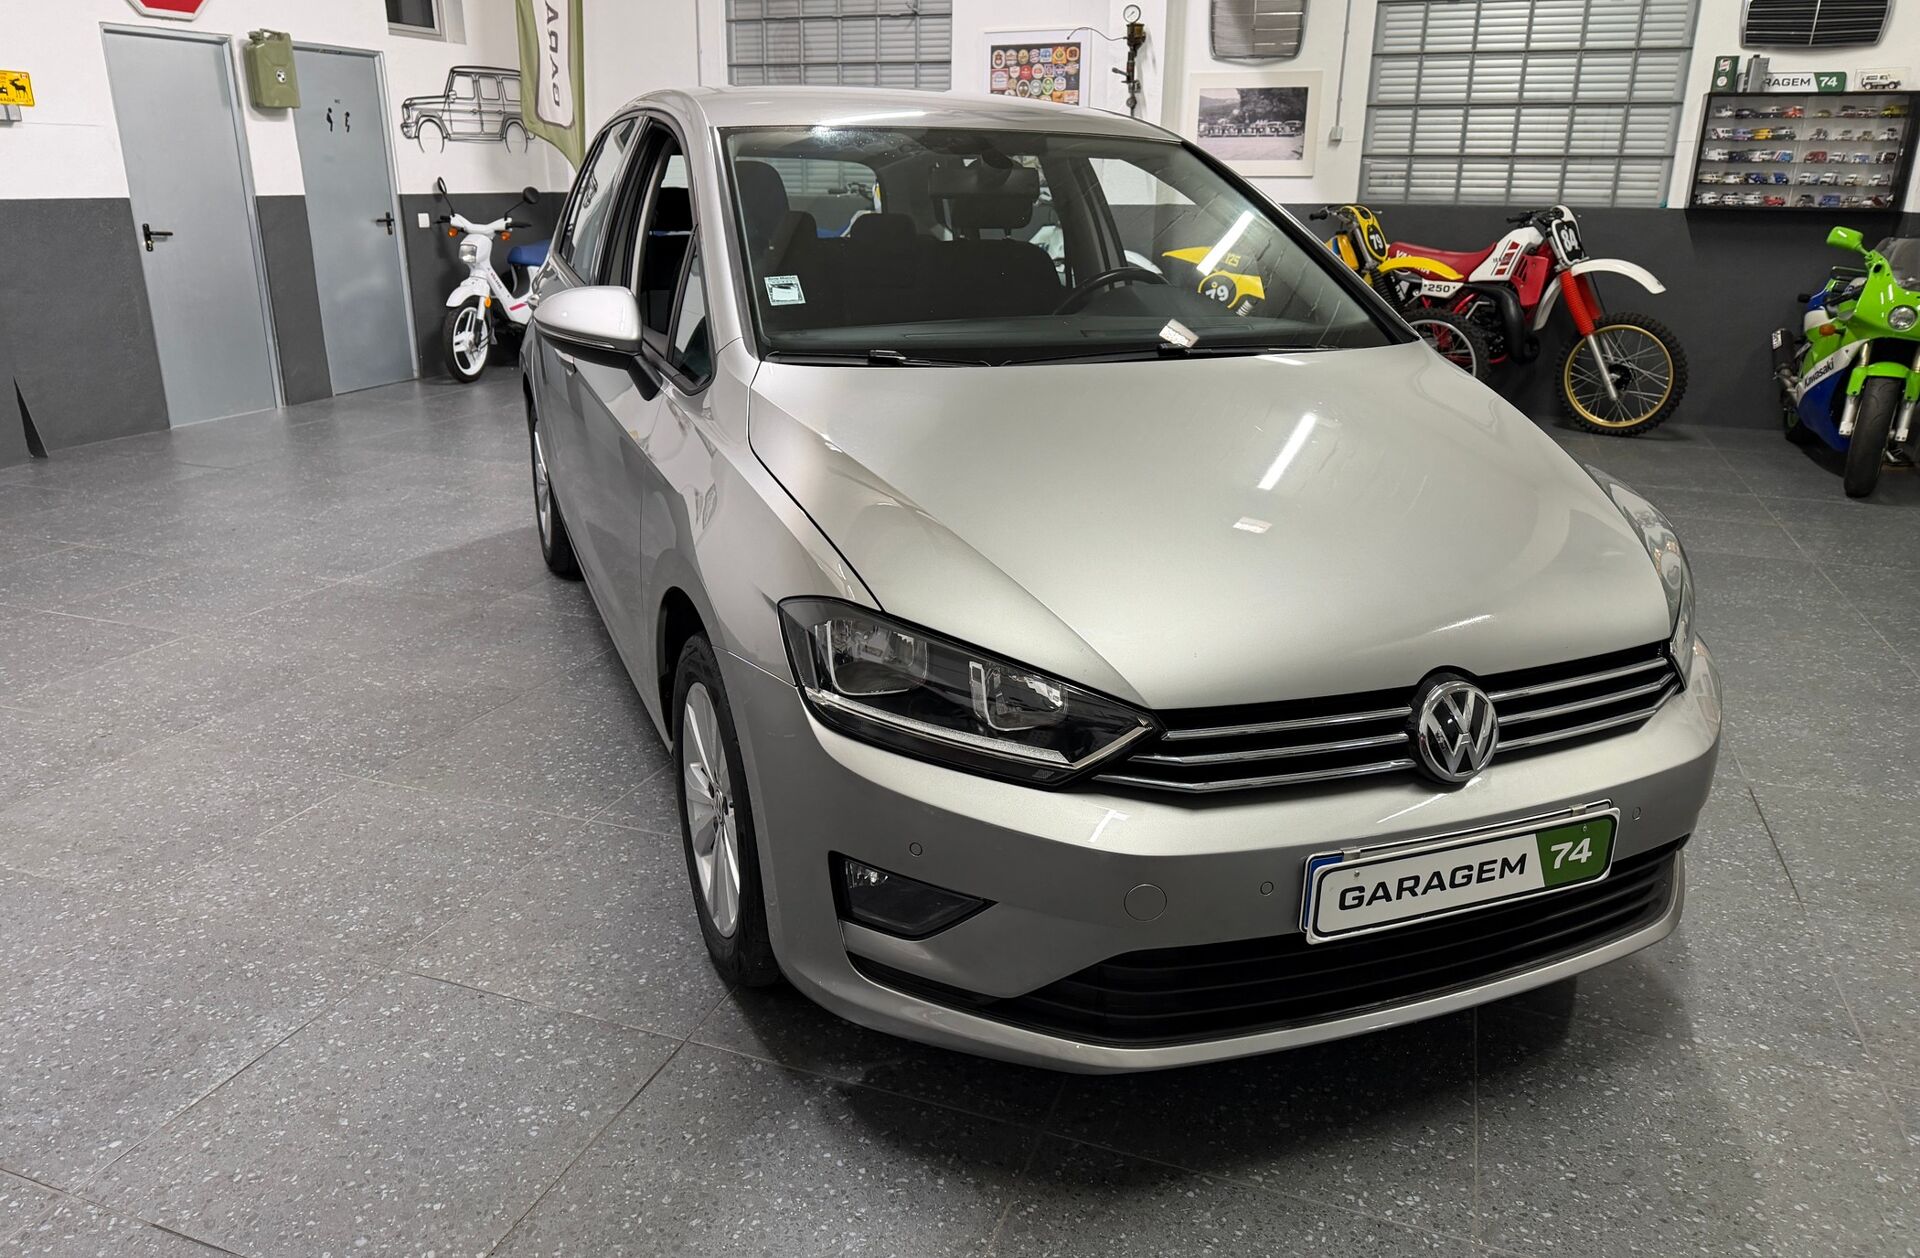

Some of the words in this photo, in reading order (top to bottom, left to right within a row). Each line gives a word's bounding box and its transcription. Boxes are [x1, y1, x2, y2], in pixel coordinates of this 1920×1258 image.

[1820, 76, 1838, 87] 74
[1369, 233, 1384, 250] 79
[1560, 228, 1580, 252] 84
[1205, 284, 1229, 302] 79
[1427, 283, 1451, 293] 250
[1804, 357, 1835, 389] Kawasaki
[1338, 853, 1528, 911] GARAGEM
[1550, 837, 1593, 870] 74
